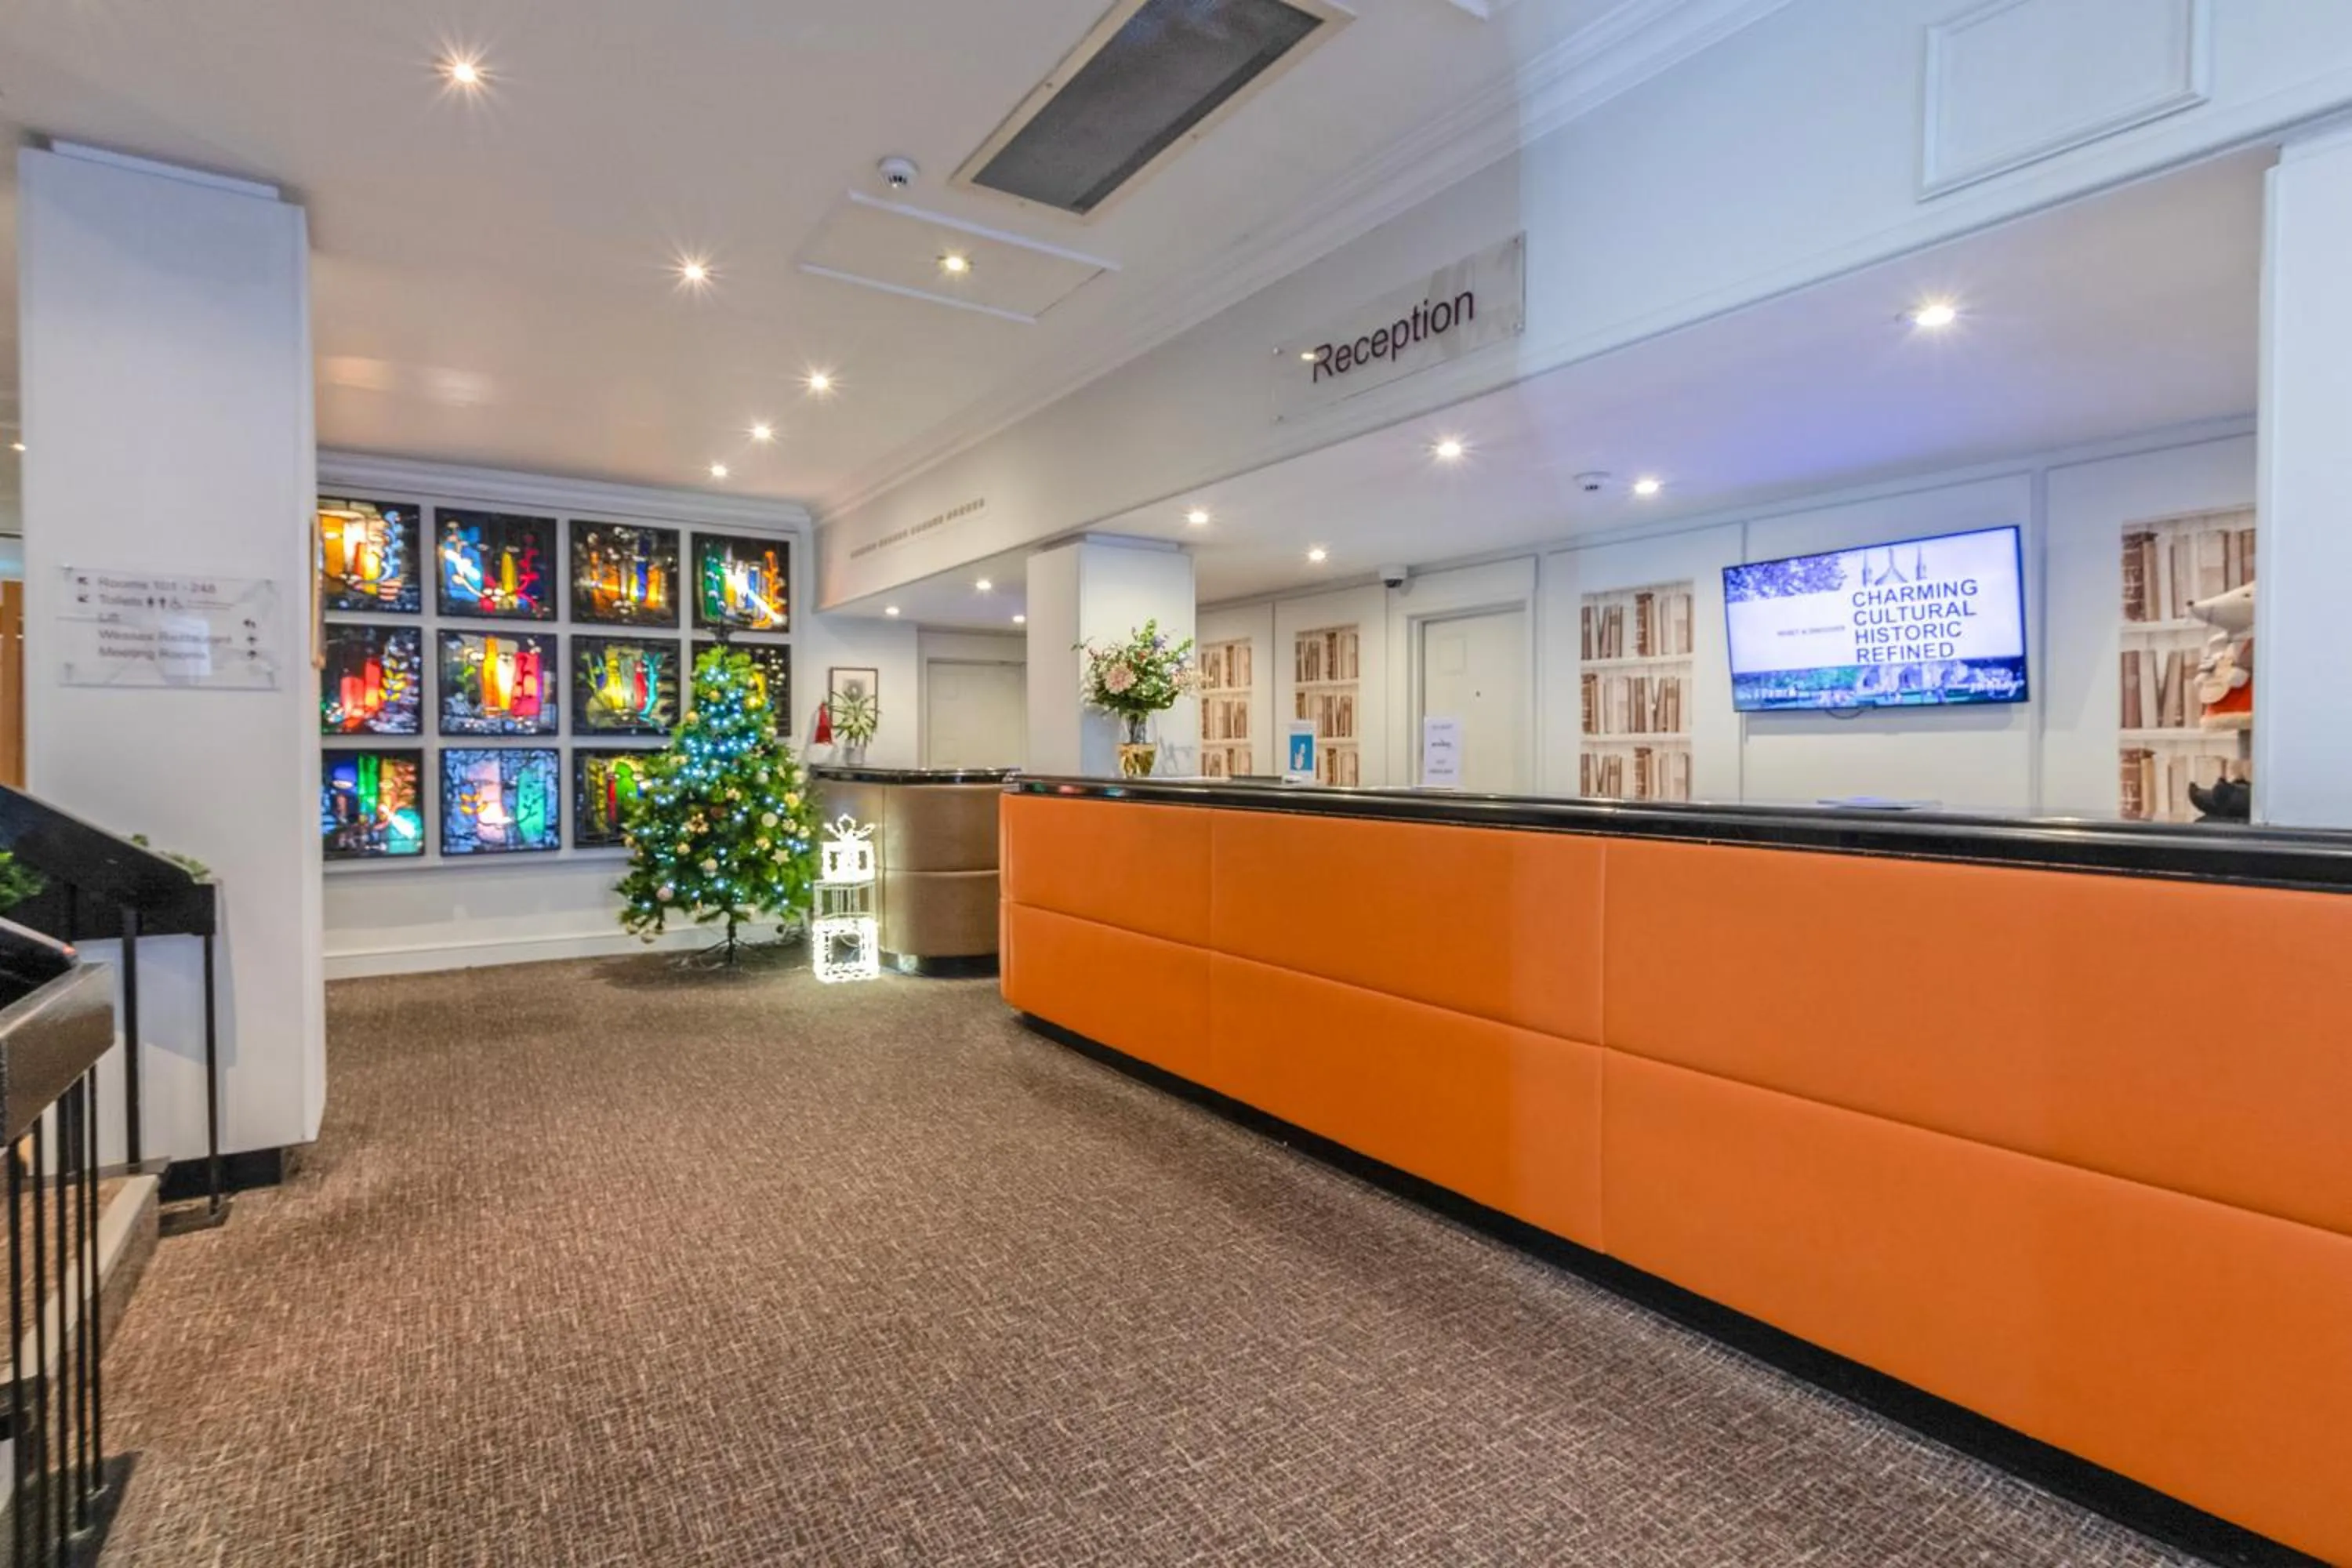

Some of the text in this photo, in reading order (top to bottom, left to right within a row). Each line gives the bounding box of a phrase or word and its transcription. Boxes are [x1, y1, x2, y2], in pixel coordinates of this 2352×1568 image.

[1312, 291, 1474, 383] Reception
[1853, 579, 1978, 608] CHARMING
[1853, 600, 1977, 626] CULTURAL
[1855, 621, 1962, 644] HISTORIC
[1857, 642, 1955, 662] REFINED
